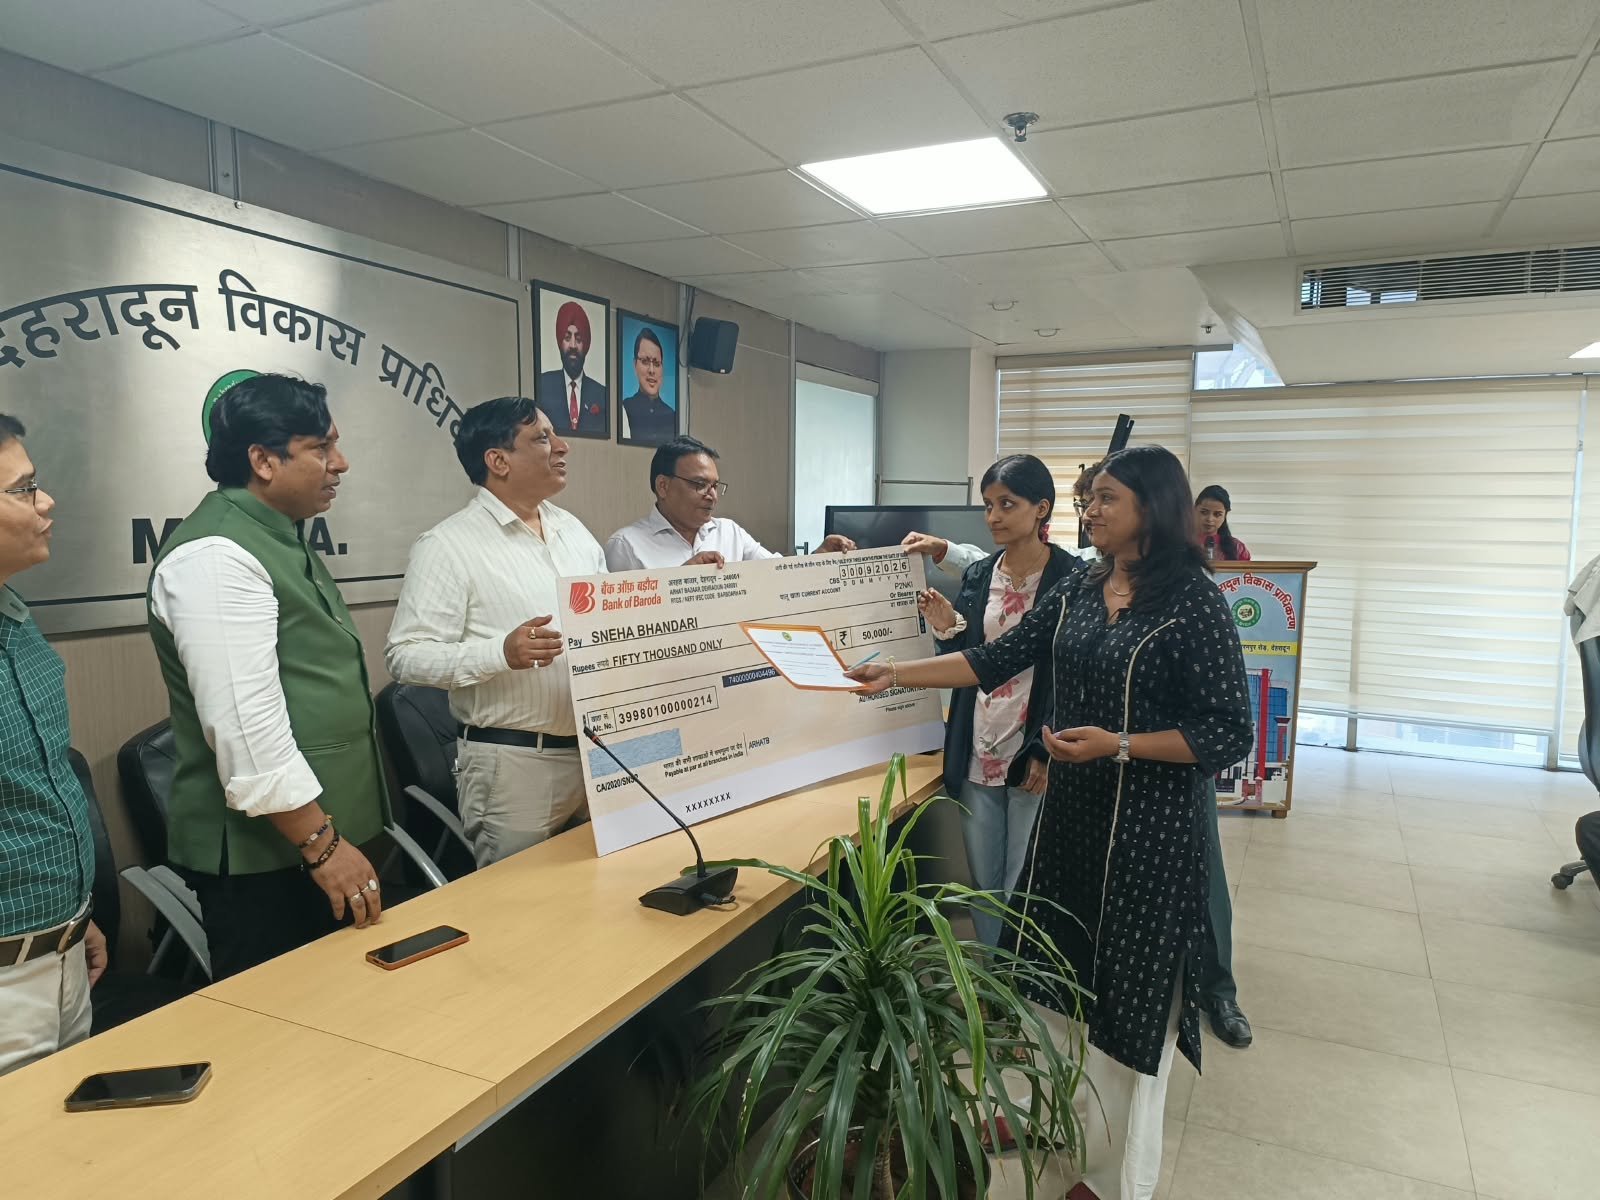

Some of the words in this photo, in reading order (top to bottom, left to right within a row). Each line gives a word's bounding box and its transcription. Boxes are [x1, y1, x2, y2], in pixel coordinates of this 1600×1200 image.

[218, 269, 366, 366] विकास
[601, 581, 615, 595] बैंक
[637, 576, 659, 592] बड़ौदा
[602, 597, 623, 611] Bank
[624, 595, 633, 608] of
[633, 593, 662, 607] Baroda
[1243, 573, 1274, 591] विकास
[1272, 587, 1296, 630] प्राधिकरण
[568, 637, 582, 648] Pay
[592, 626, 635, 643] SNEHA
[637, 617, 698, 637] BHANDARI
[862, 627, 893, 640] 50,000/-
[572, 663, 596, 673] Rupees
[613, 652, 641, 667] FIFTY
[643, 643, 697, 661] THOUSAND
[699, 638, 722, 652] ONLY
[618, 694, 713, 724] 39980100000214
[748, 736, 770, 750] ARHATB
[665, 767, 684, 778] Payable
[689, 764, 697, 772] par
[709, 754, 728, 766] branches
